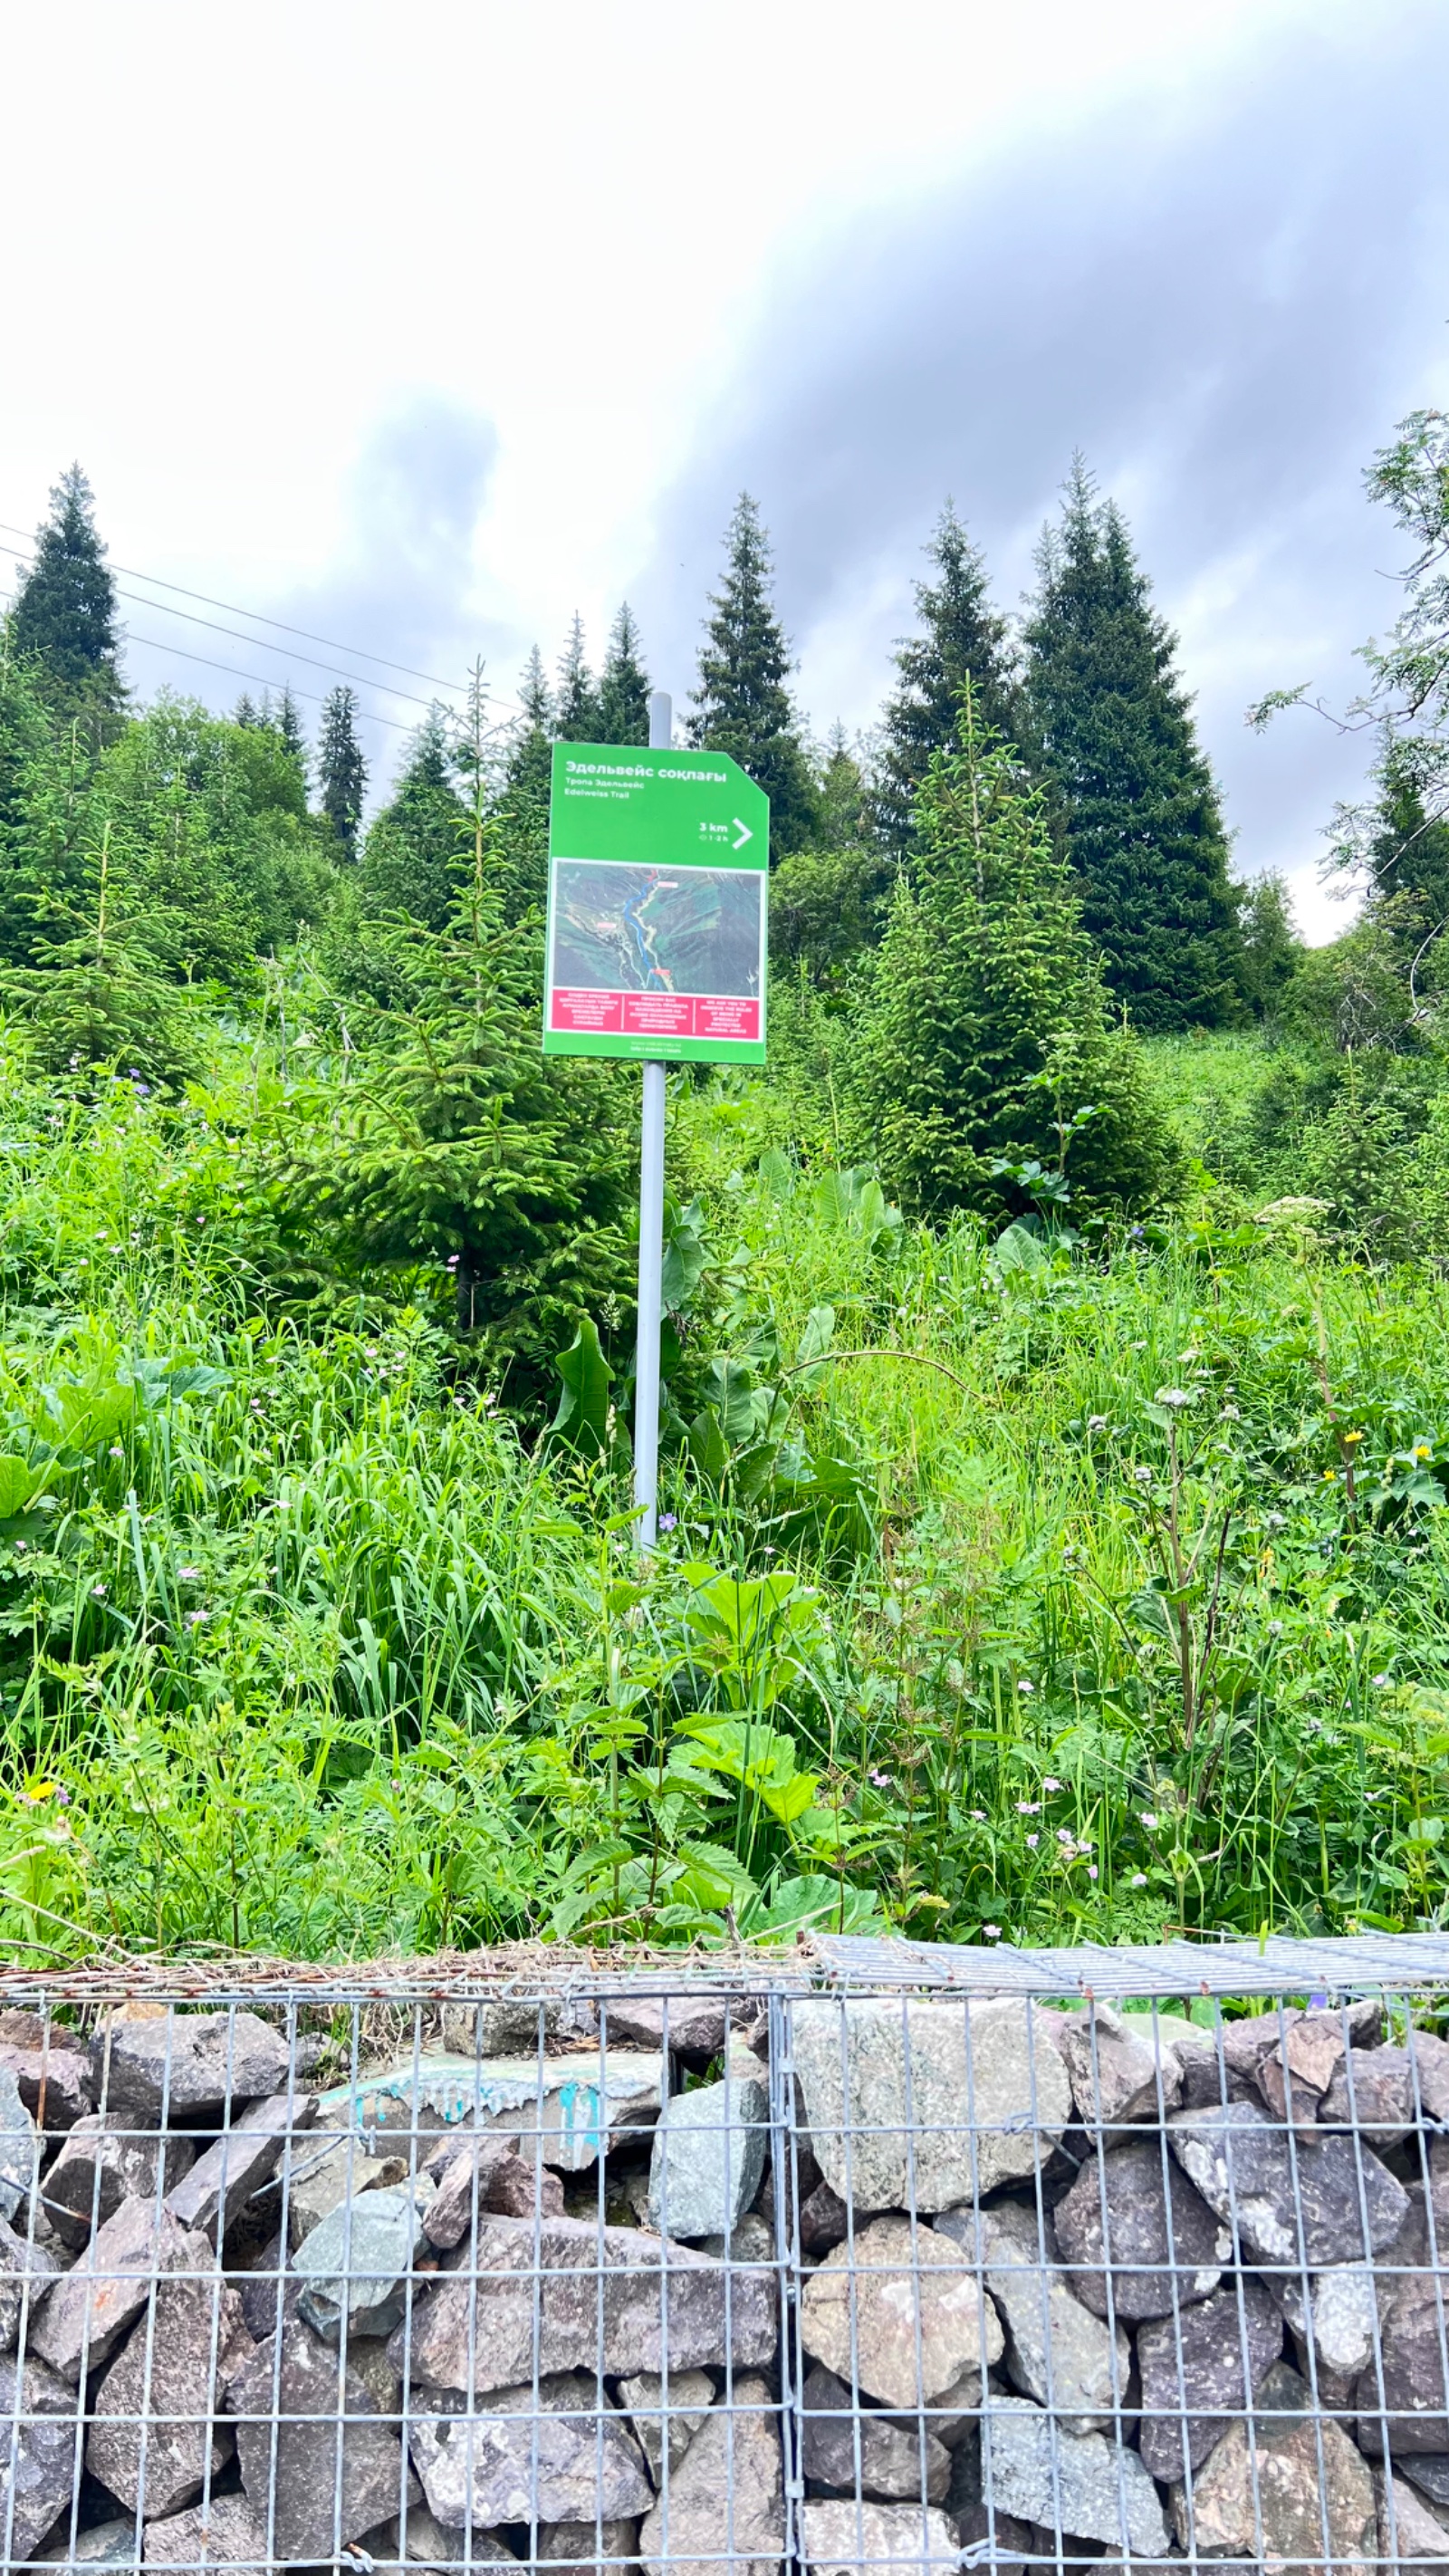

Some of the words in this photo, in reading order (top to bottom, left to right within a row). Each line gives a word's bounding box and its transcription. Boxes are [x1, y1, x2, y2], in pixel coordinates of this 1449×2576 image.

[566, 760, 654, 777] Эдельвейс
[657, 768, 726, 783] соқпағы
[565, 776, 593, 786] Тропа
[595, 779, 645, 789] Эдельвейс
[564, 787, 609, 798] Edelweiss
[610, 790, 629, 799] Trail
[699, 822, 706, 831] 3
[709, 822, 728, 832] km
